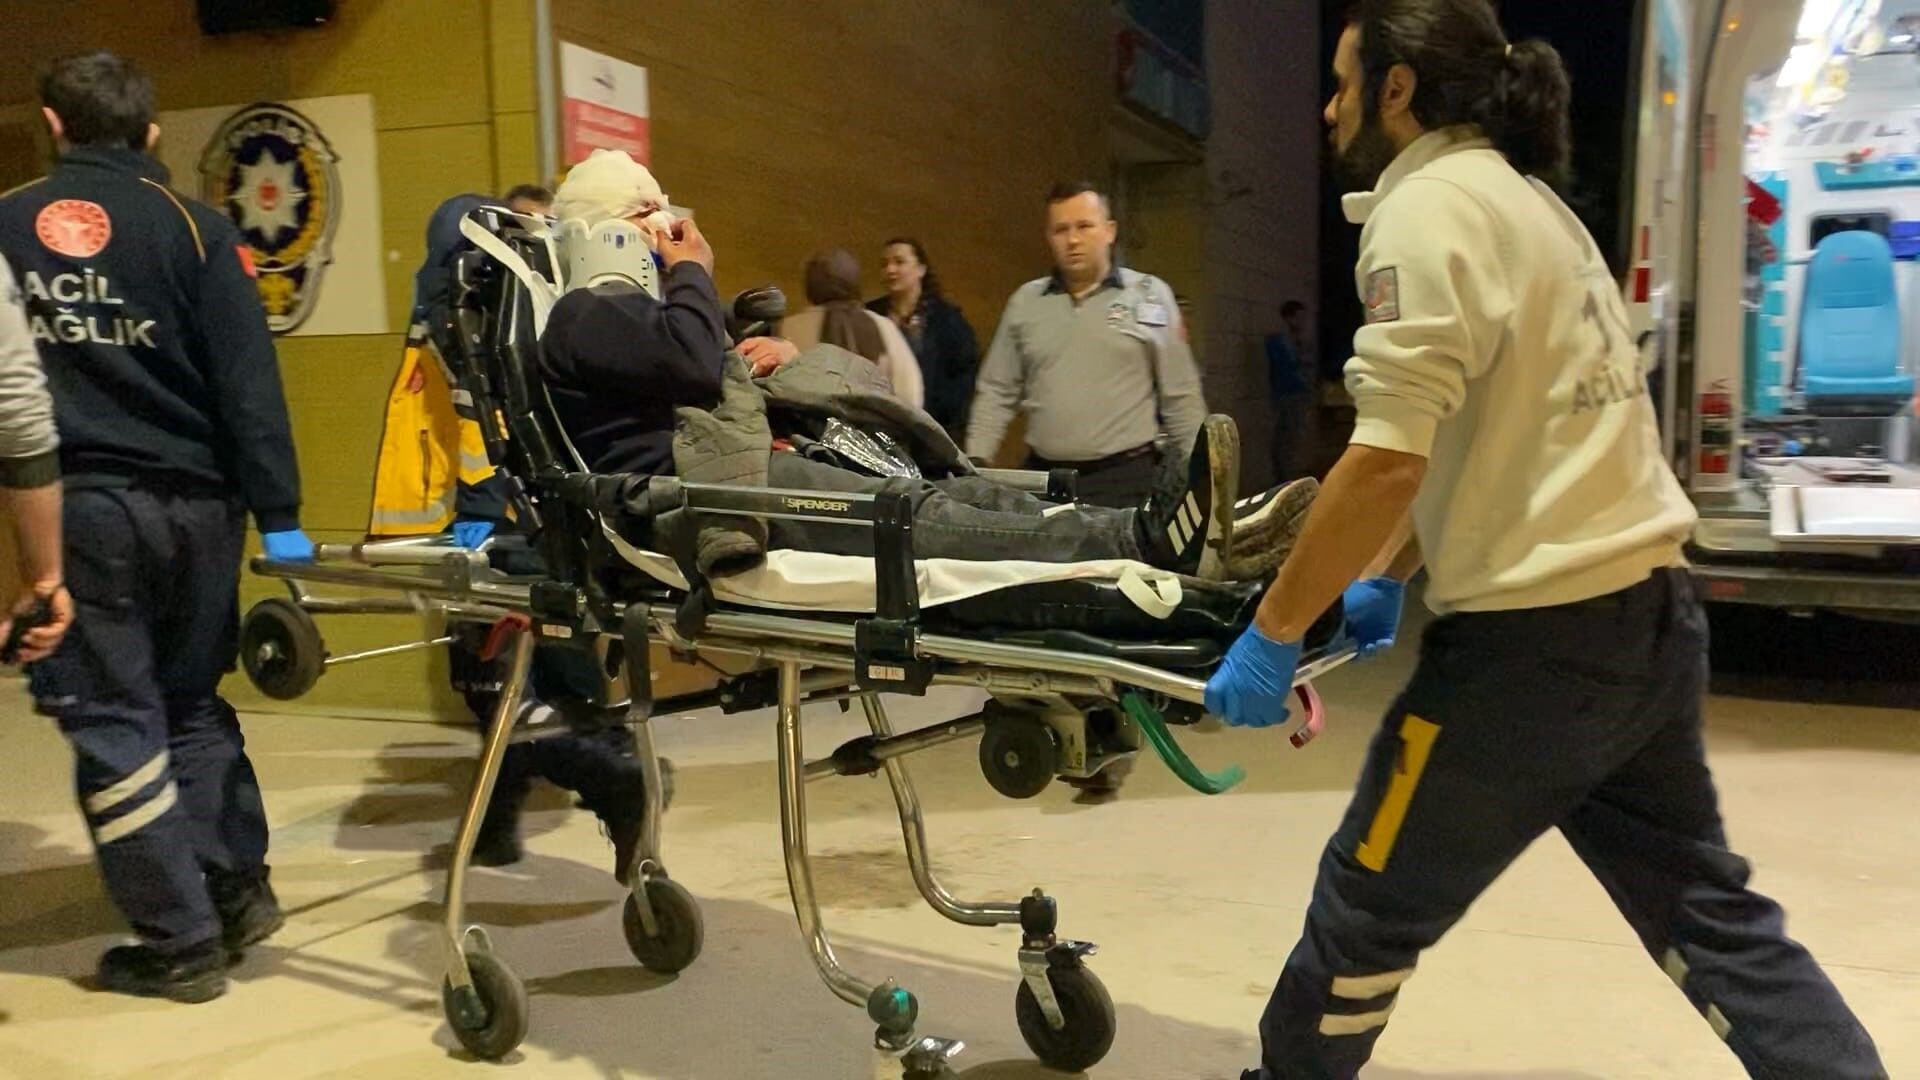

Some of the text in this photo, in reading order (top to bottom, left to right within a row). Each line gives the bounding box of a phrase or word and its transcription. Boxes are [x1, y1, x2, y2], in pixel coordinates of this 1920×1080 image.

[24, 267, 124, 304] ACİL
[31, 307, 156, 348] AĞLIK
[786, 498, 849, 512] SPENCER
